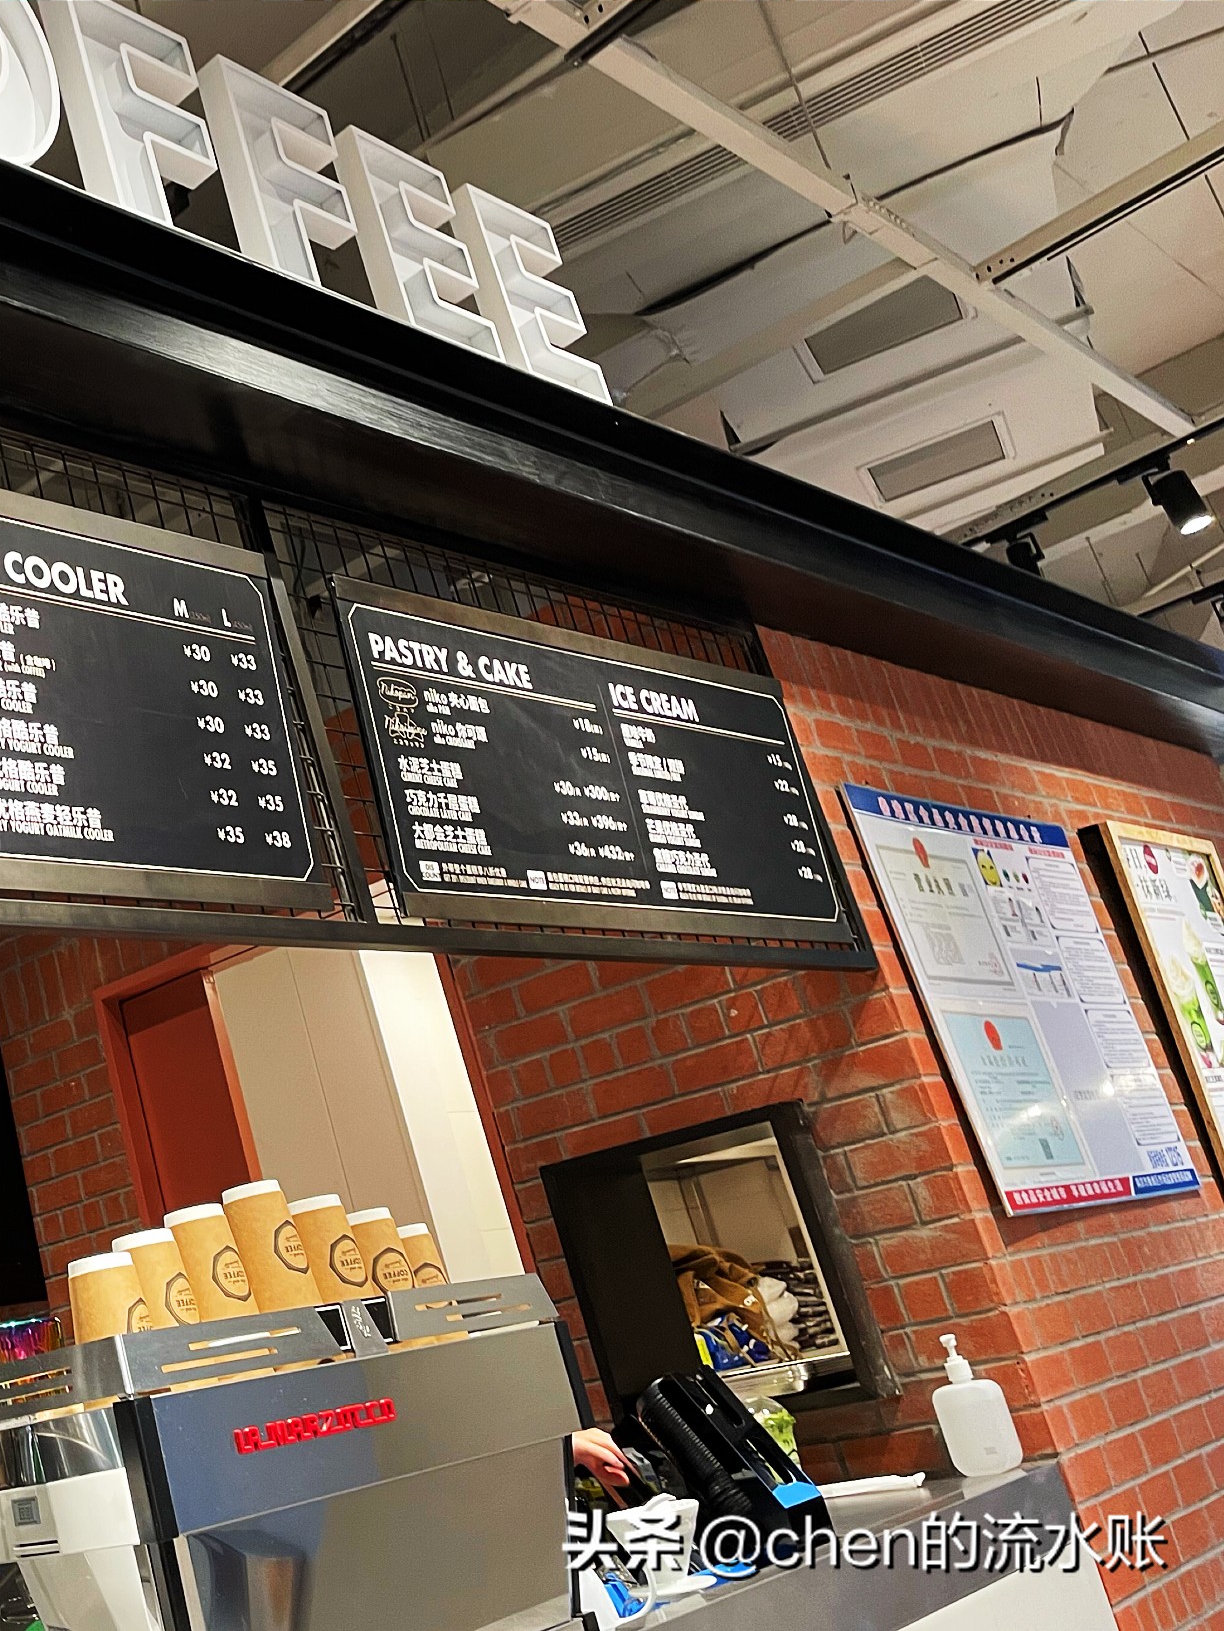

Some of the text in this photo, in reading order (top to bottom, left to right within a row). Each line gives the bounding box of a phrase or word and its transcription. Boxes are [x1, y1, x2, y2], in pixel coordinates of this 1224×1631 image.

[3, 550, 129, 606] COOLER
[173, 598, 189, 619] M
[221, 608, 232, 628] L
[183, 643, 211, 662] ¥30
[230, 653, 257, 671] ¥33
[368, 632, 533, 690] PASTRY & CAKE
[190, 679, 219, 698] ¥30
[238, 688, 264, 706] ¥33
[0, 697, 33, 714] COOLER
[608, 682, 700, 723] ICE CREAM
[197, 715, 225, 734] ¥30
[244, 722, 271, 741] ¥33
[8, 739, 42, 754] YOGURT
[43, 744, 75, 759] COOLER
[203, 751, 232, 770] ¥32
[251, 758, 277, 776] ¥35
[26, 781, 59, 797] COOLER
[210, 788, 239, 807] ¥32
[258, 794, 284, 812] ¥35
[10, 819, 45, 836] YOGURT
[84, 827, 114, 842] COOLER
[217, 825, 245, 844] ¥35
[264, 831, 291, 848] ¥38
